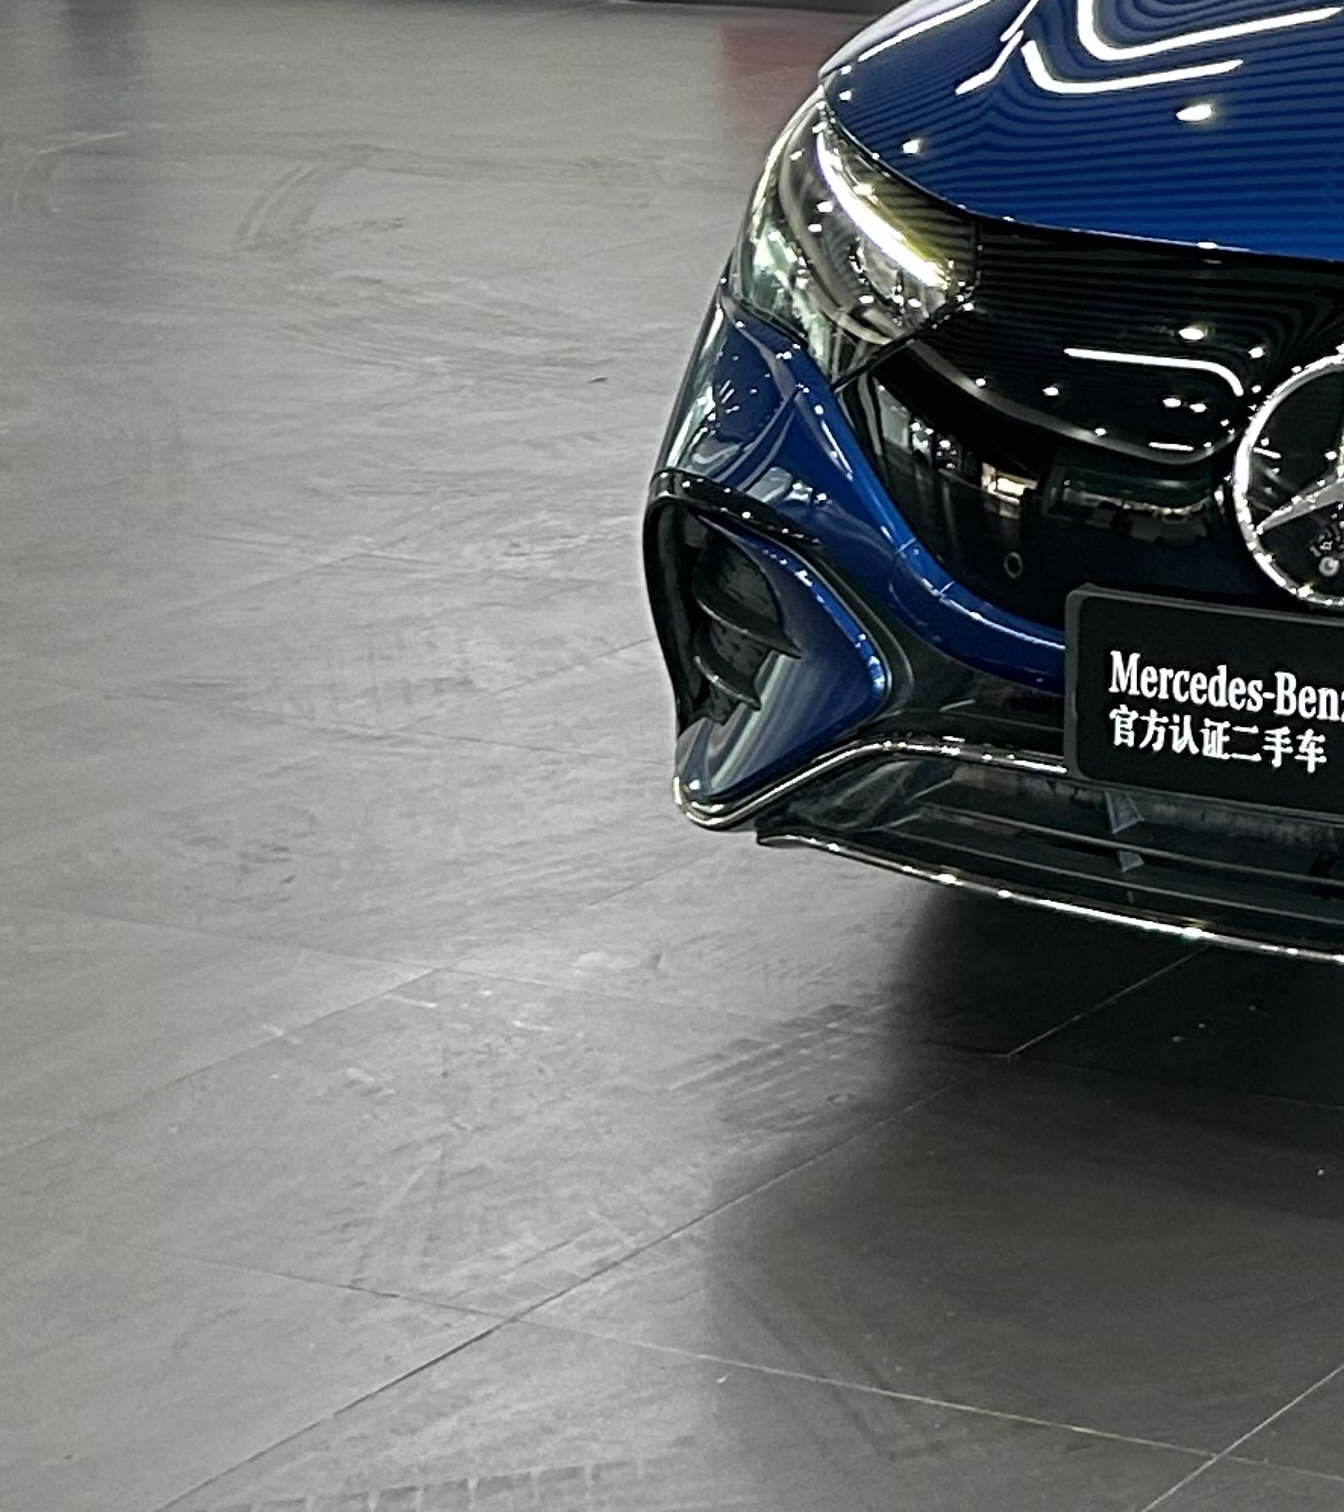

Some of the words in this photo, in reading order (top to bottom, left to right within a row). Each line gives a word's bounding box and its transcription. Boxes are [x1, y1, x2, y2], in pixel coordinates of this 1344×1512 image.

[1107, 702, 1328, 775] 官方认证二手车
